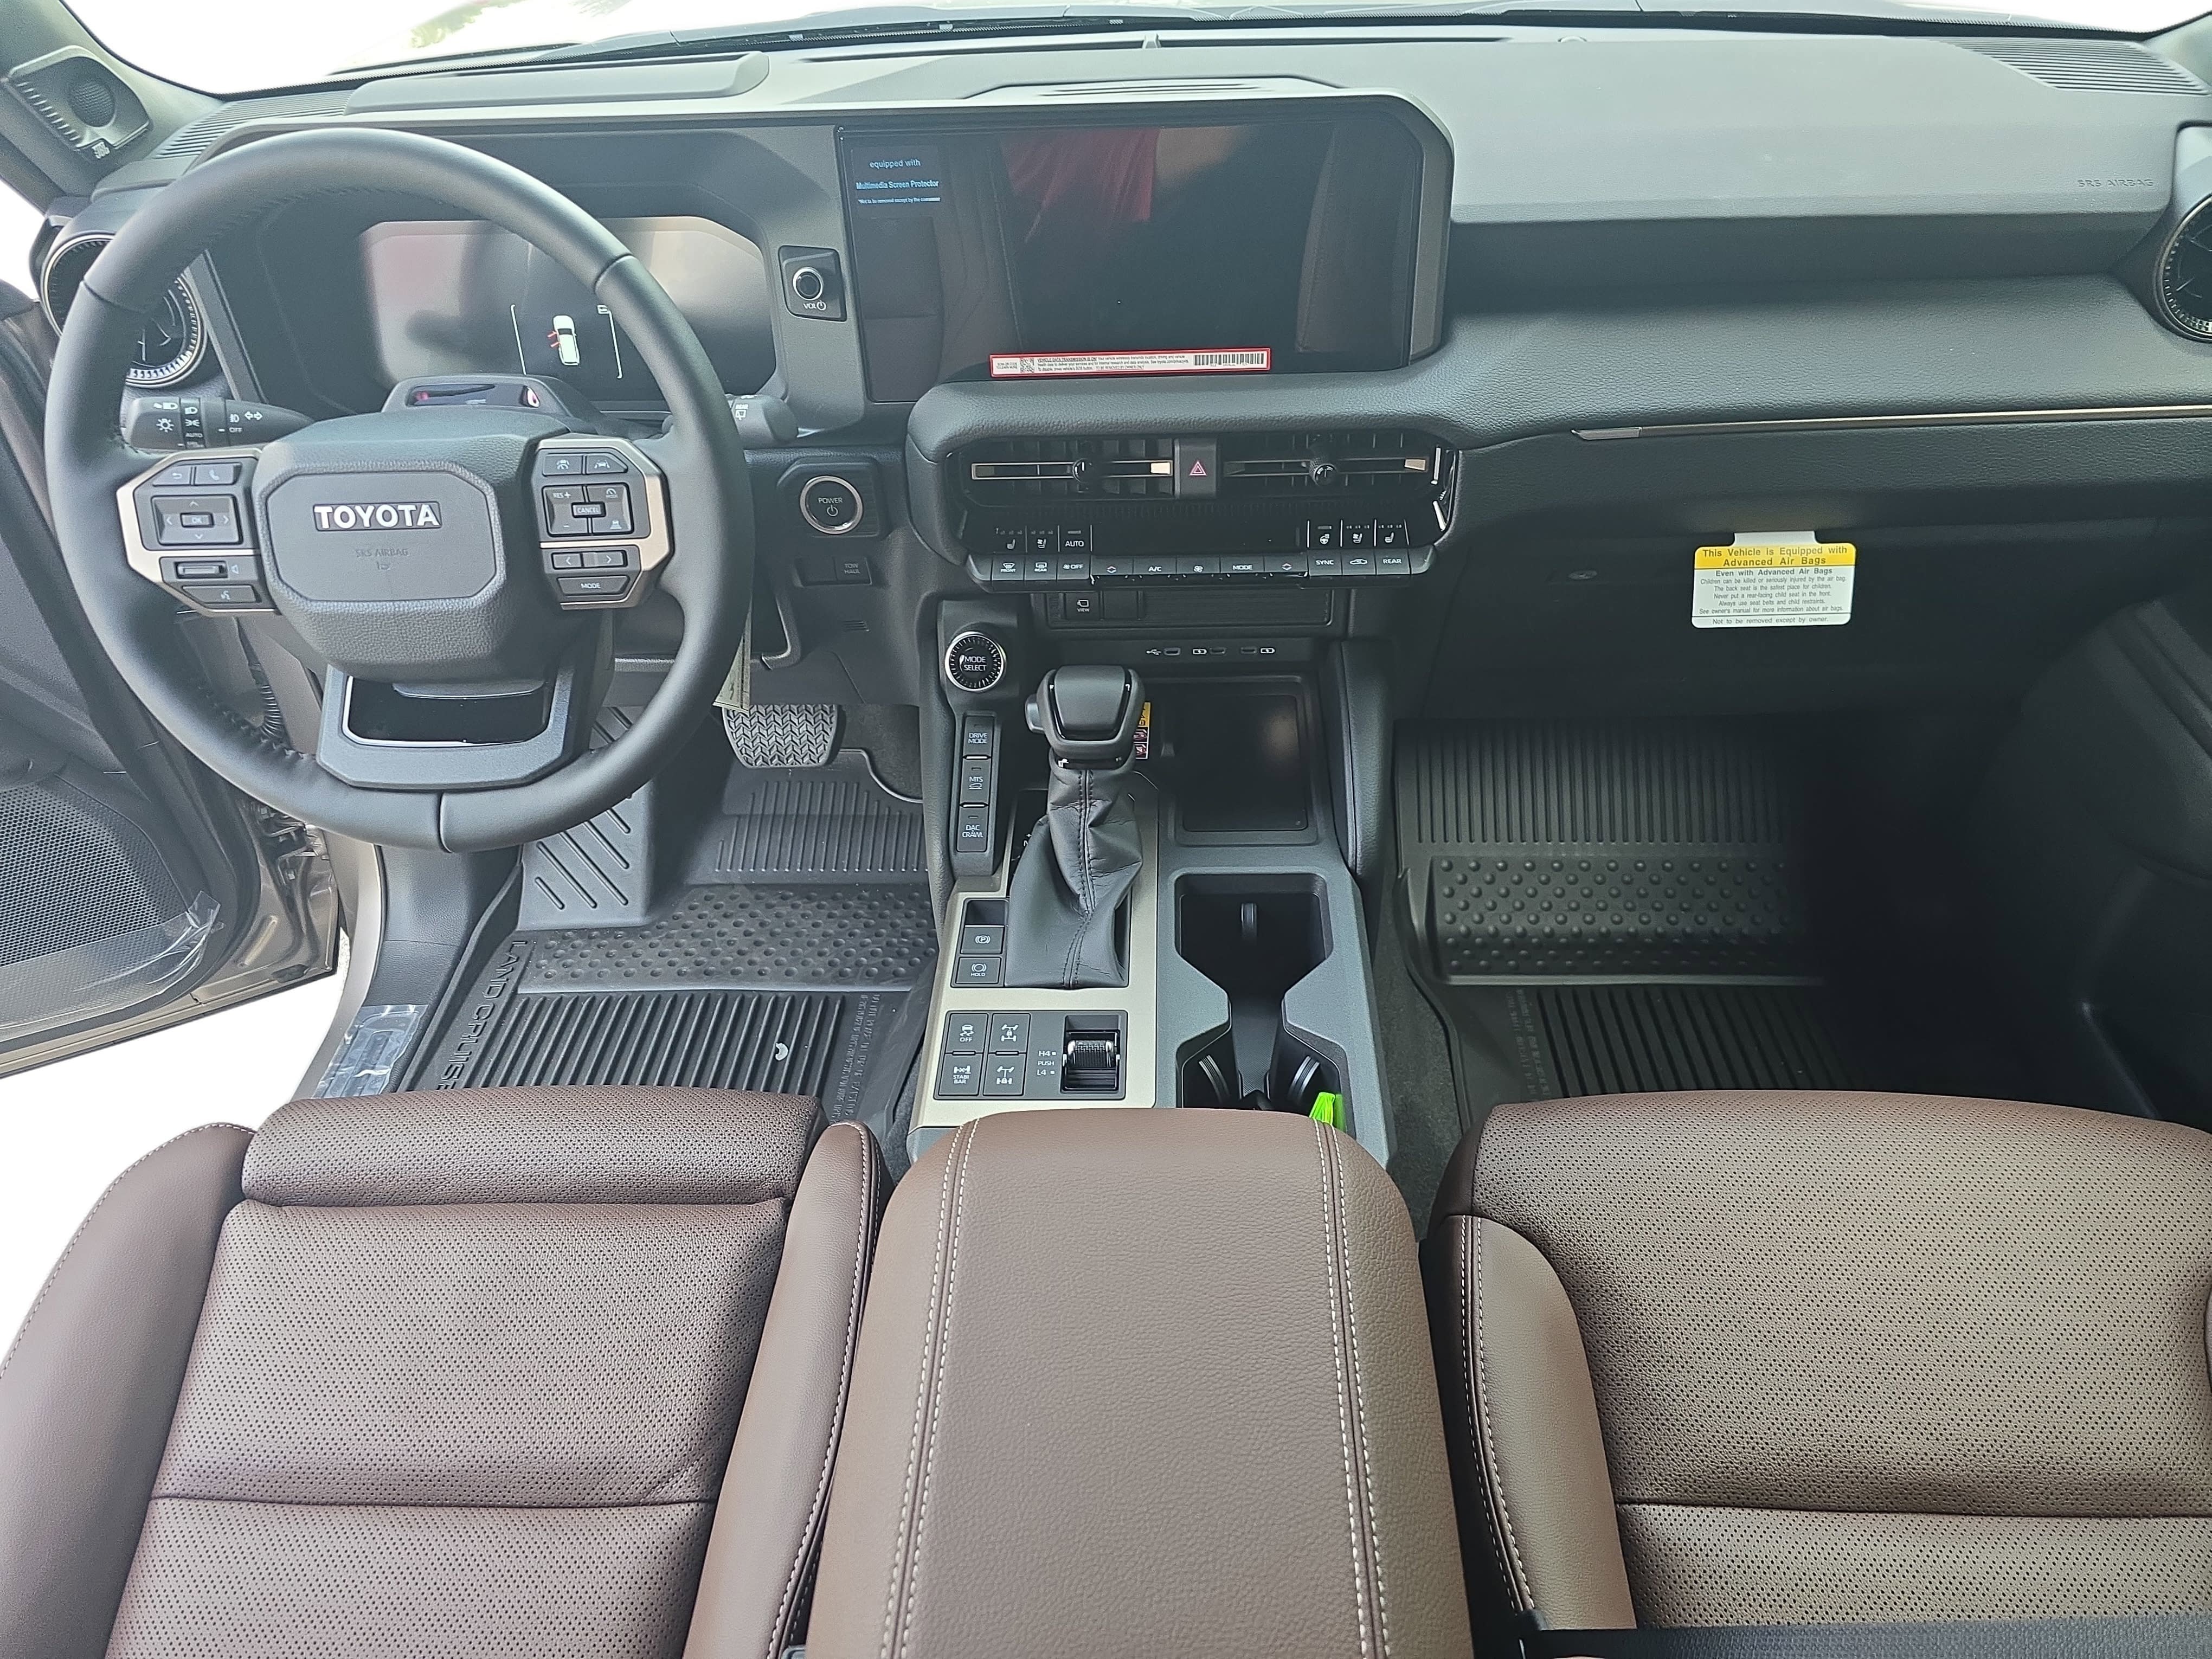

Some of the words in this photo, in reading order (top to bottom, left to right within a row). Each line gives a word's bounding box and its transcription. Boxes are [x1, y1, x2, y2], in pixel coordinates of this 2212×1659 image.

[870, 160, 903, 169] equipped
[2077, 179, 2101, 187] SRS
[314, 504, 440, 529] TOYOTA
[356, 549, 371, 557] SRS
[375, 548, 409, 556] AIRBAG
[1702, 549, 1722, 557] This
[1728, 548, 1761, 556] Vehicle
[1780, 546, 1823, 556] Equipped
[1723, 557, 1772, 567] Advanced
[1780, 557, 1794, 565] Air
[1801, 557, 1826, 565] Bags
[482, 941, 528, 999] LAND
